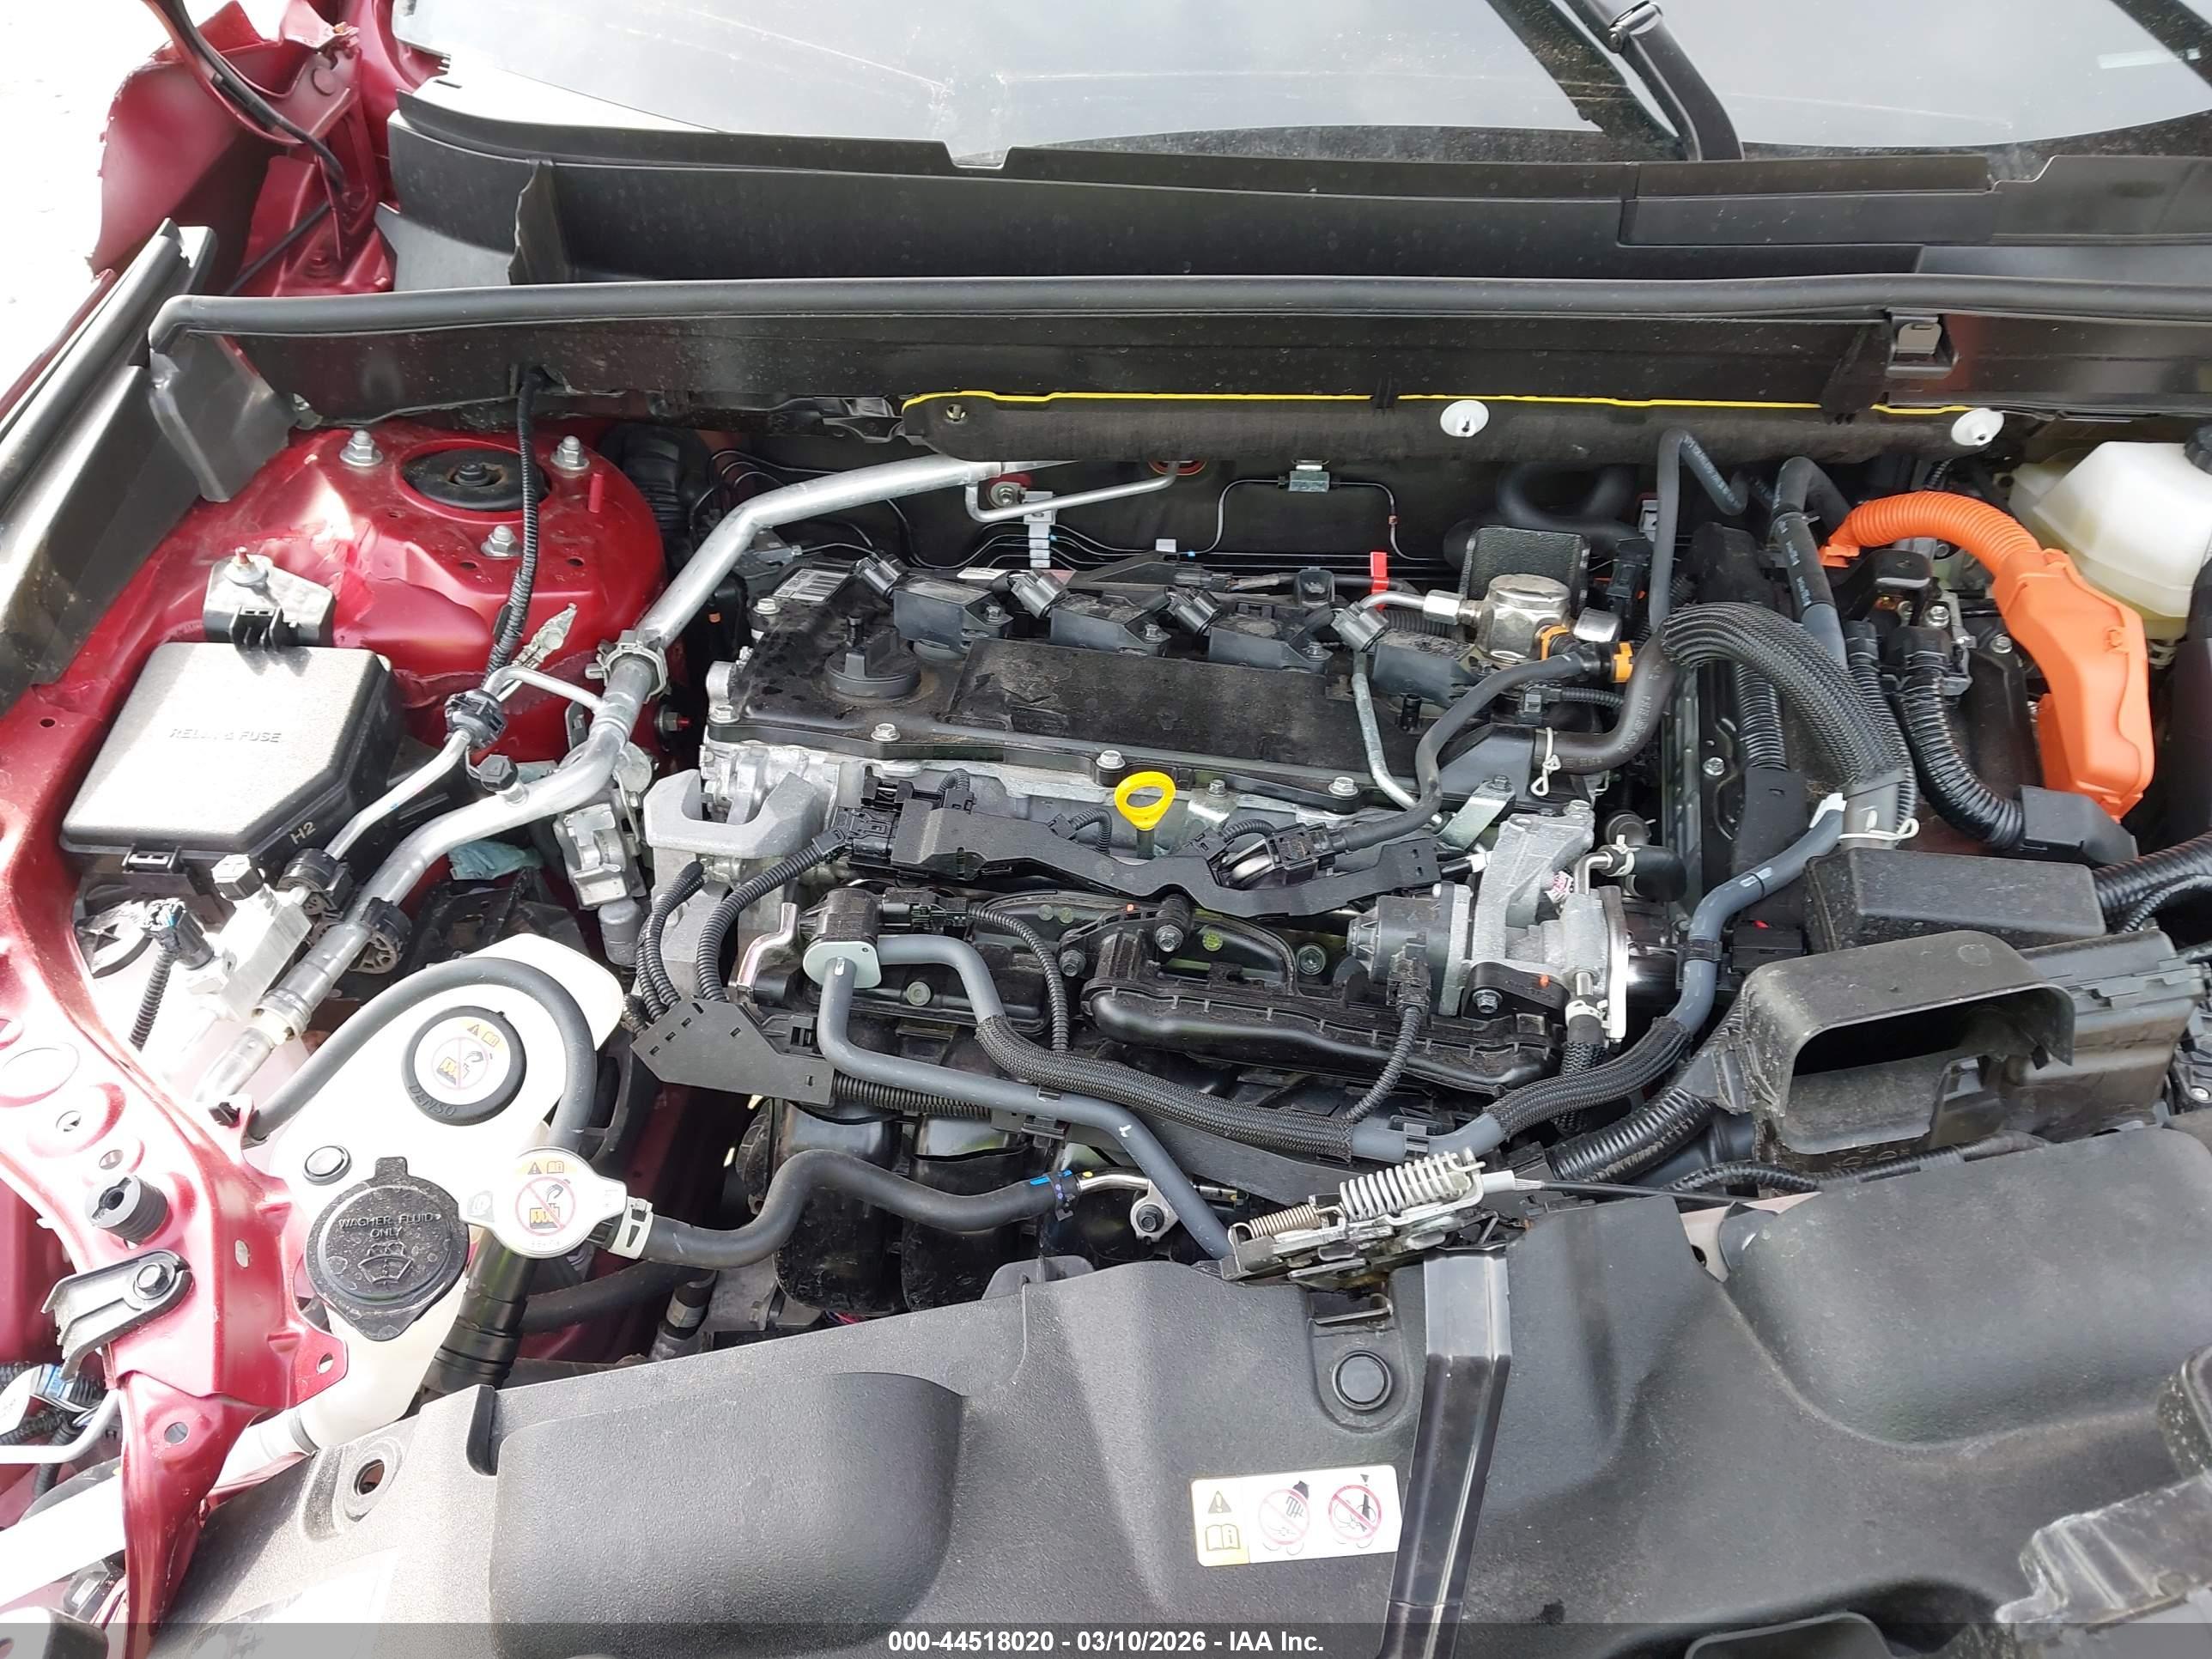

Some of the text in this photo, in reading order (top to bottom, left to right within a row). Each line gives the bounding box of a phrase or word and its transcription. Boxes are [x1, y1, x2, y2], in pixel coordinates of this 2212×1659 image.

[239, 730, 282, 743] FUSE
[290, 821, 317, 845] H2
[408, 1085, 457, 1117] DENSO
[398, 1212, 433, 1225] FLUID
[369, 1225, 403, 1238] ONLY
